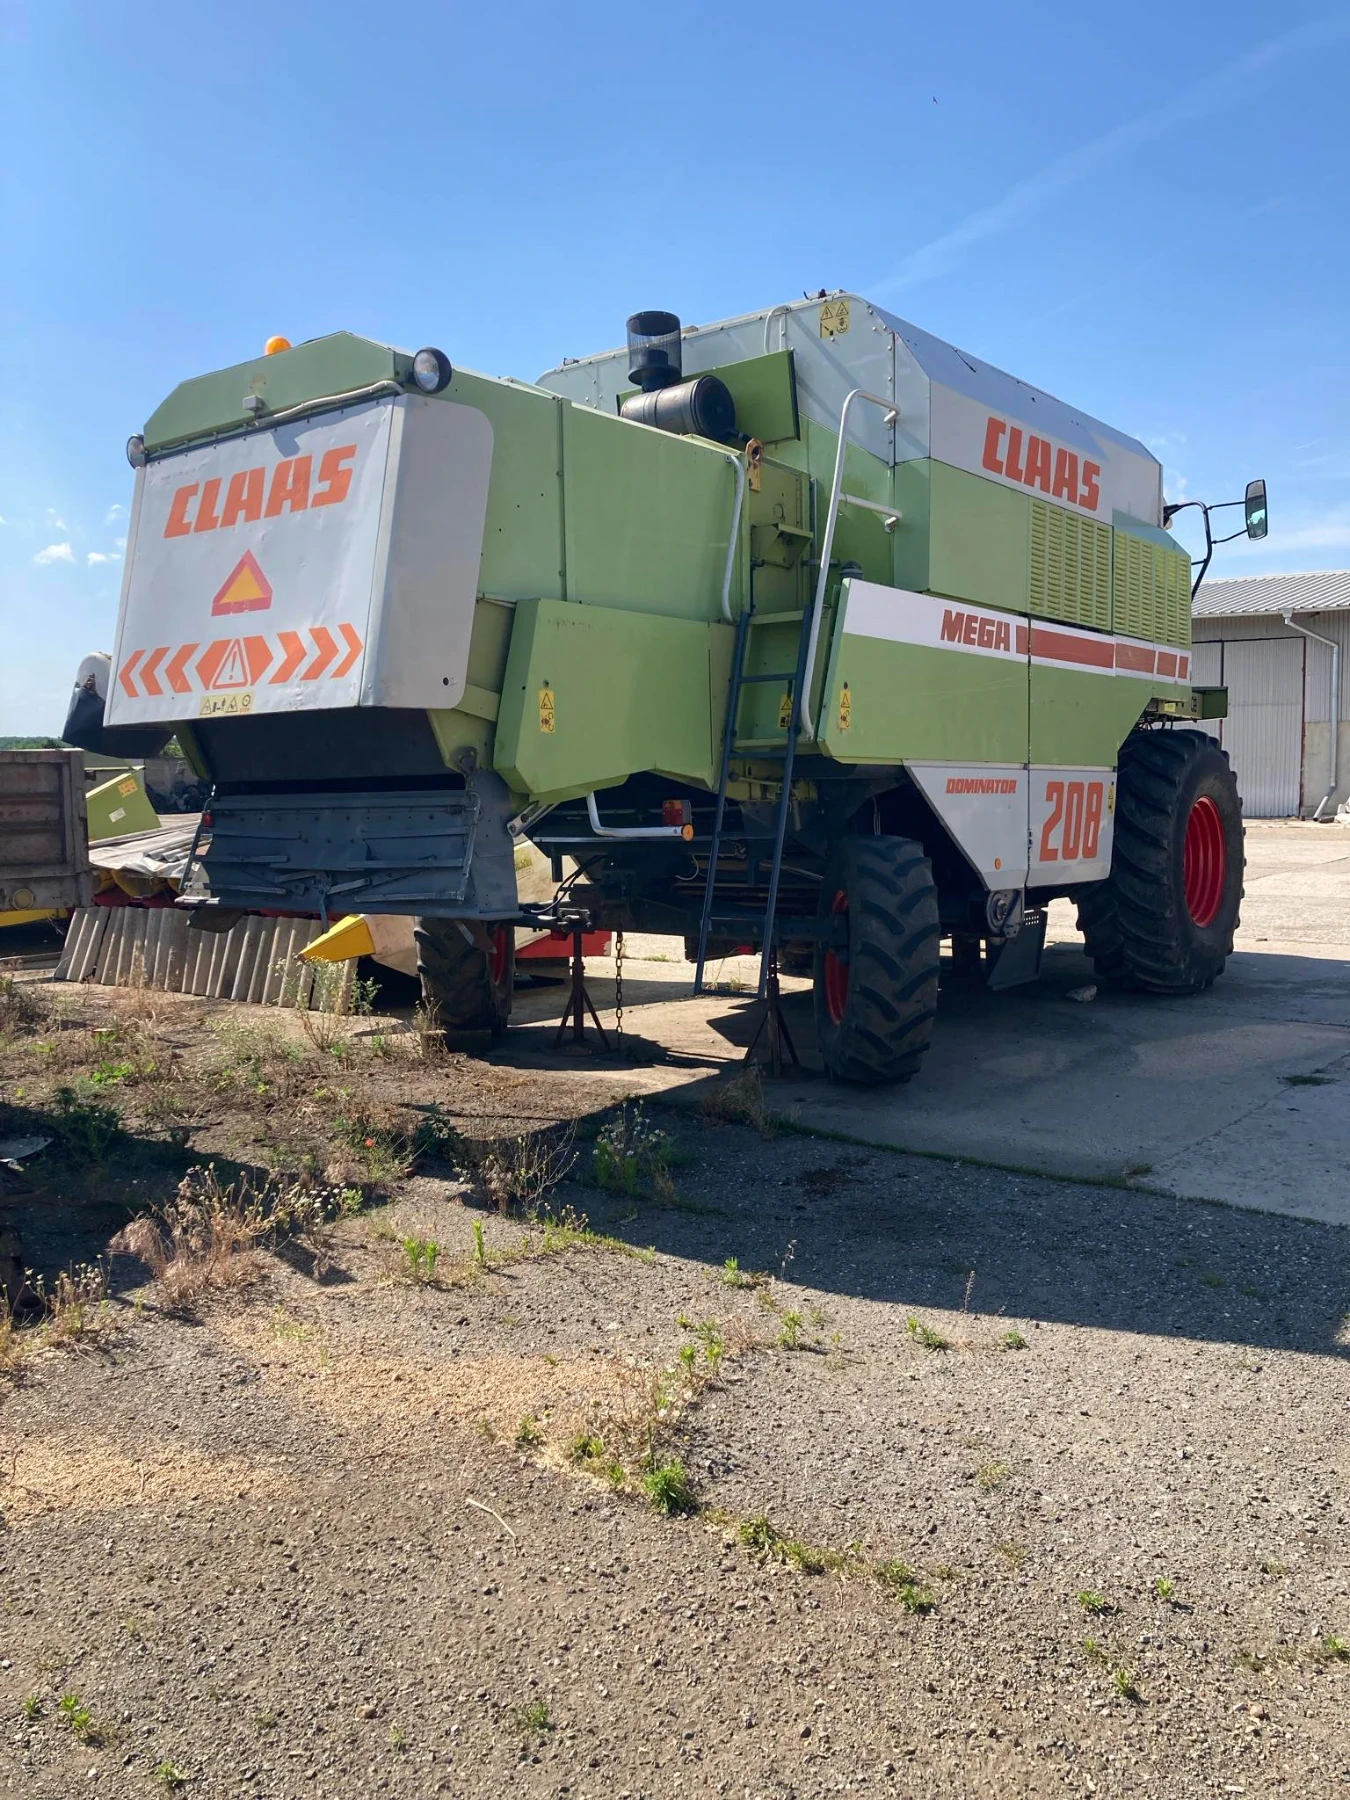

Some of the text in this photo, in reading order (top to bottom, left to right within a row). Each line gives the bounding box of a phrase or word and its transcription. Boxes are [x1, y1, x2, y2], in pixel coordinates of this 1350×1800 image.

[164, 444, 357, 539] CLAAS
[982, 416, 1101, 512] CLAAS
[941, 609, 1010, 652] MEGA
[945, 778, 1017, 794] DOMINATOR
[1039, 781, 1104, 861] 208
